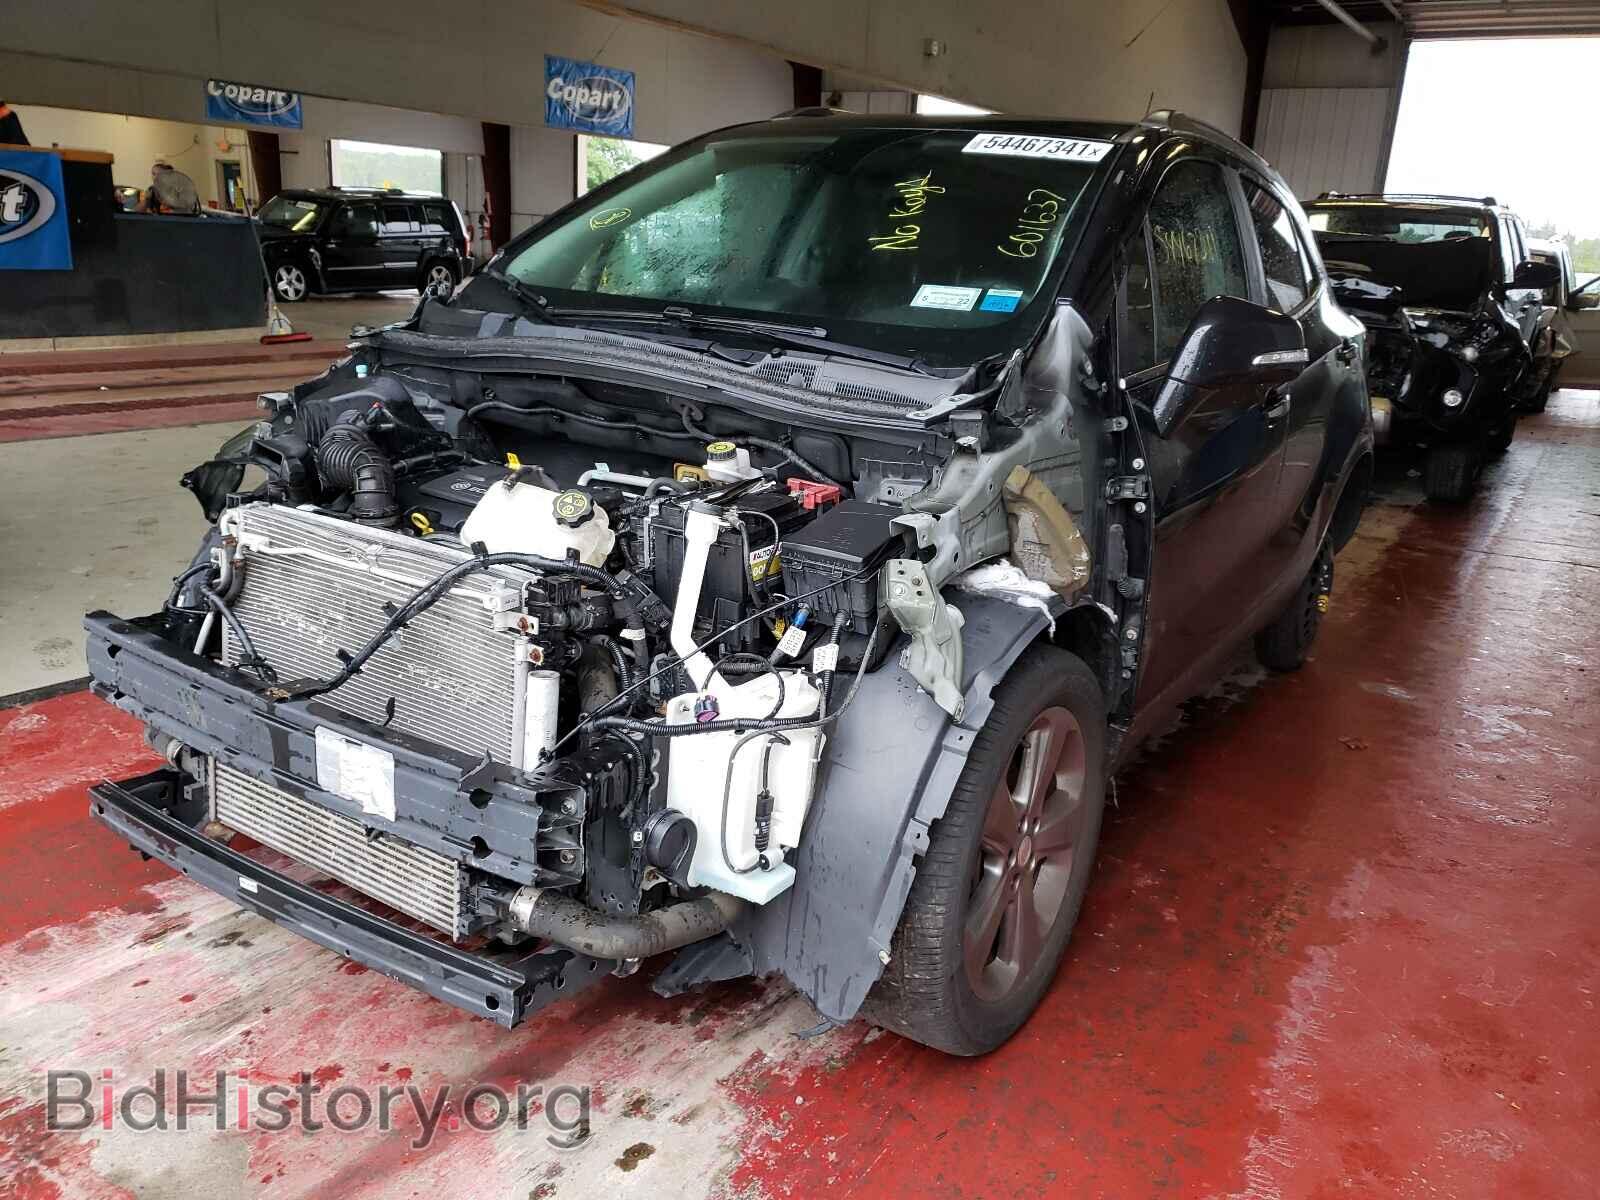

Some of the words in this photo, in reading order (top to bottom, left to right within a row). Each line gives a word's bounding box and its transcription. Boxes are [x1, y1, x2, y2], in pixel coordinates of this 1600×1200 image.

[207, 80, 287, 106] Copart
[547, 77, 622, 111] Copart
[868, 224, 921, 251] No
[997, 188, 1067, 258] 601637
